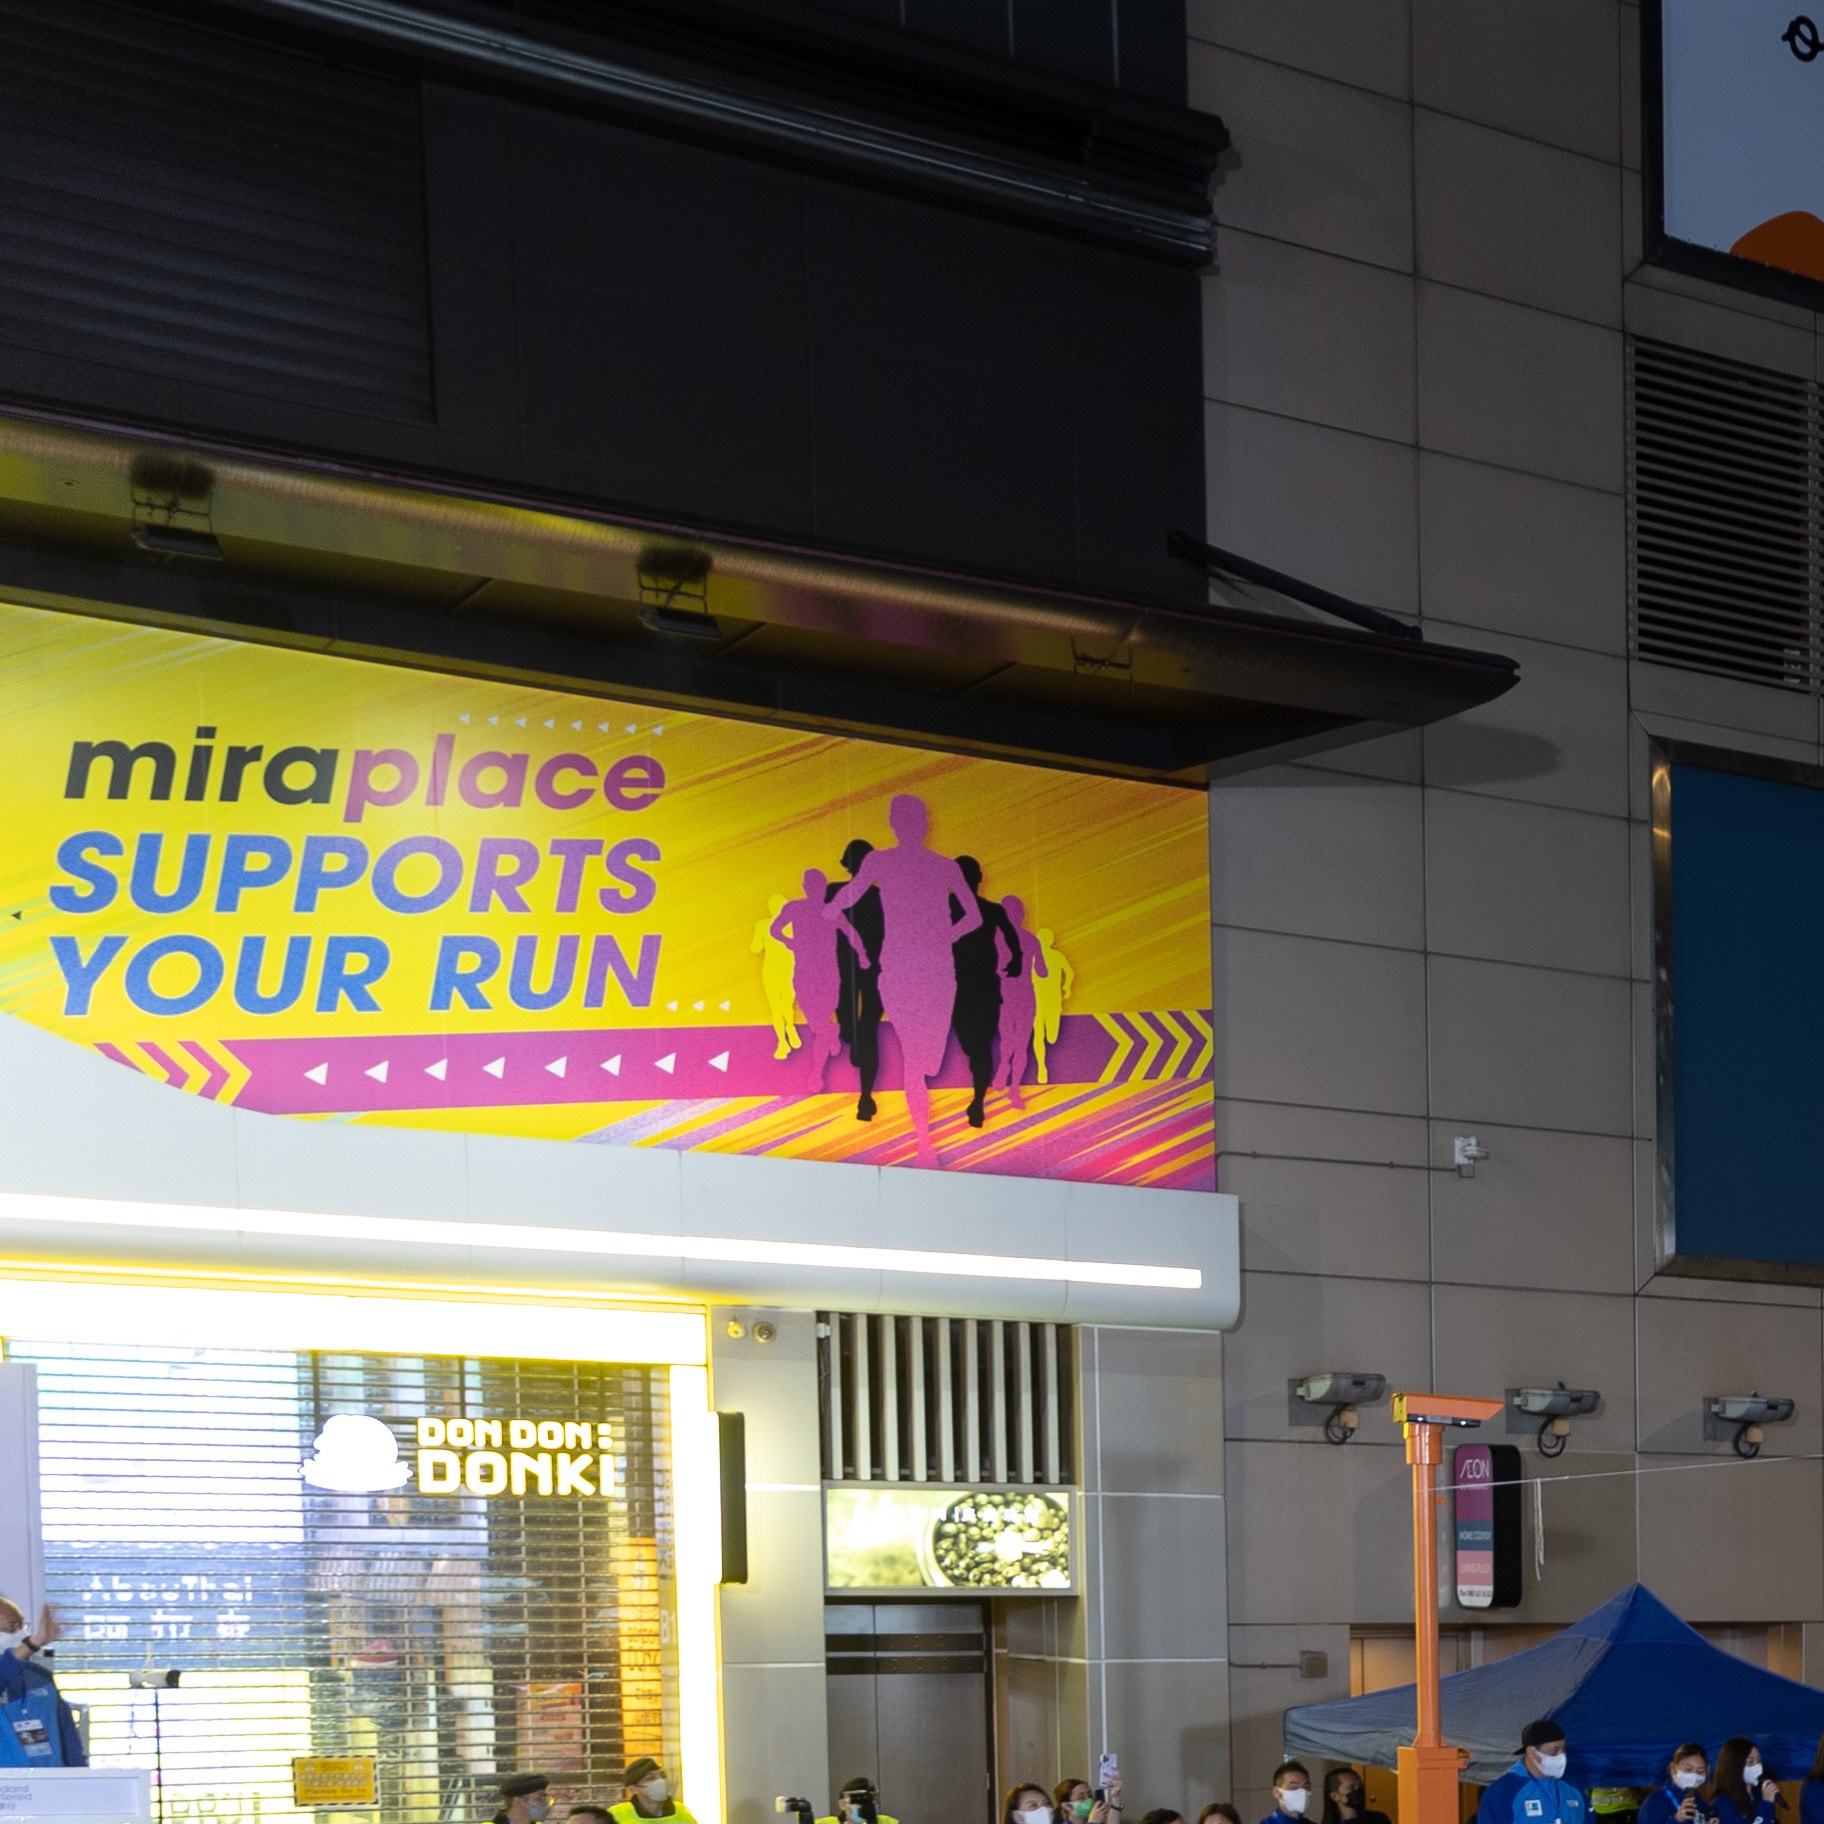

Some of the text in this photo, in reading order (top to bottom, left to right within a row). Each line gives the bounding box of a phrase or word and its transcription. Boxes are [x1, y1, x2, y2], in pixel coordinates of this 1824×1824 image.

[63, 724, 667, 823] miraplace
[48, 831, 663, 915] SUPPORTS
[48, 933, 663, 1018] YOUR RUN
[416, 1418, 504, 1448] DON
[416, 1449, 617, 1497] DONKI
